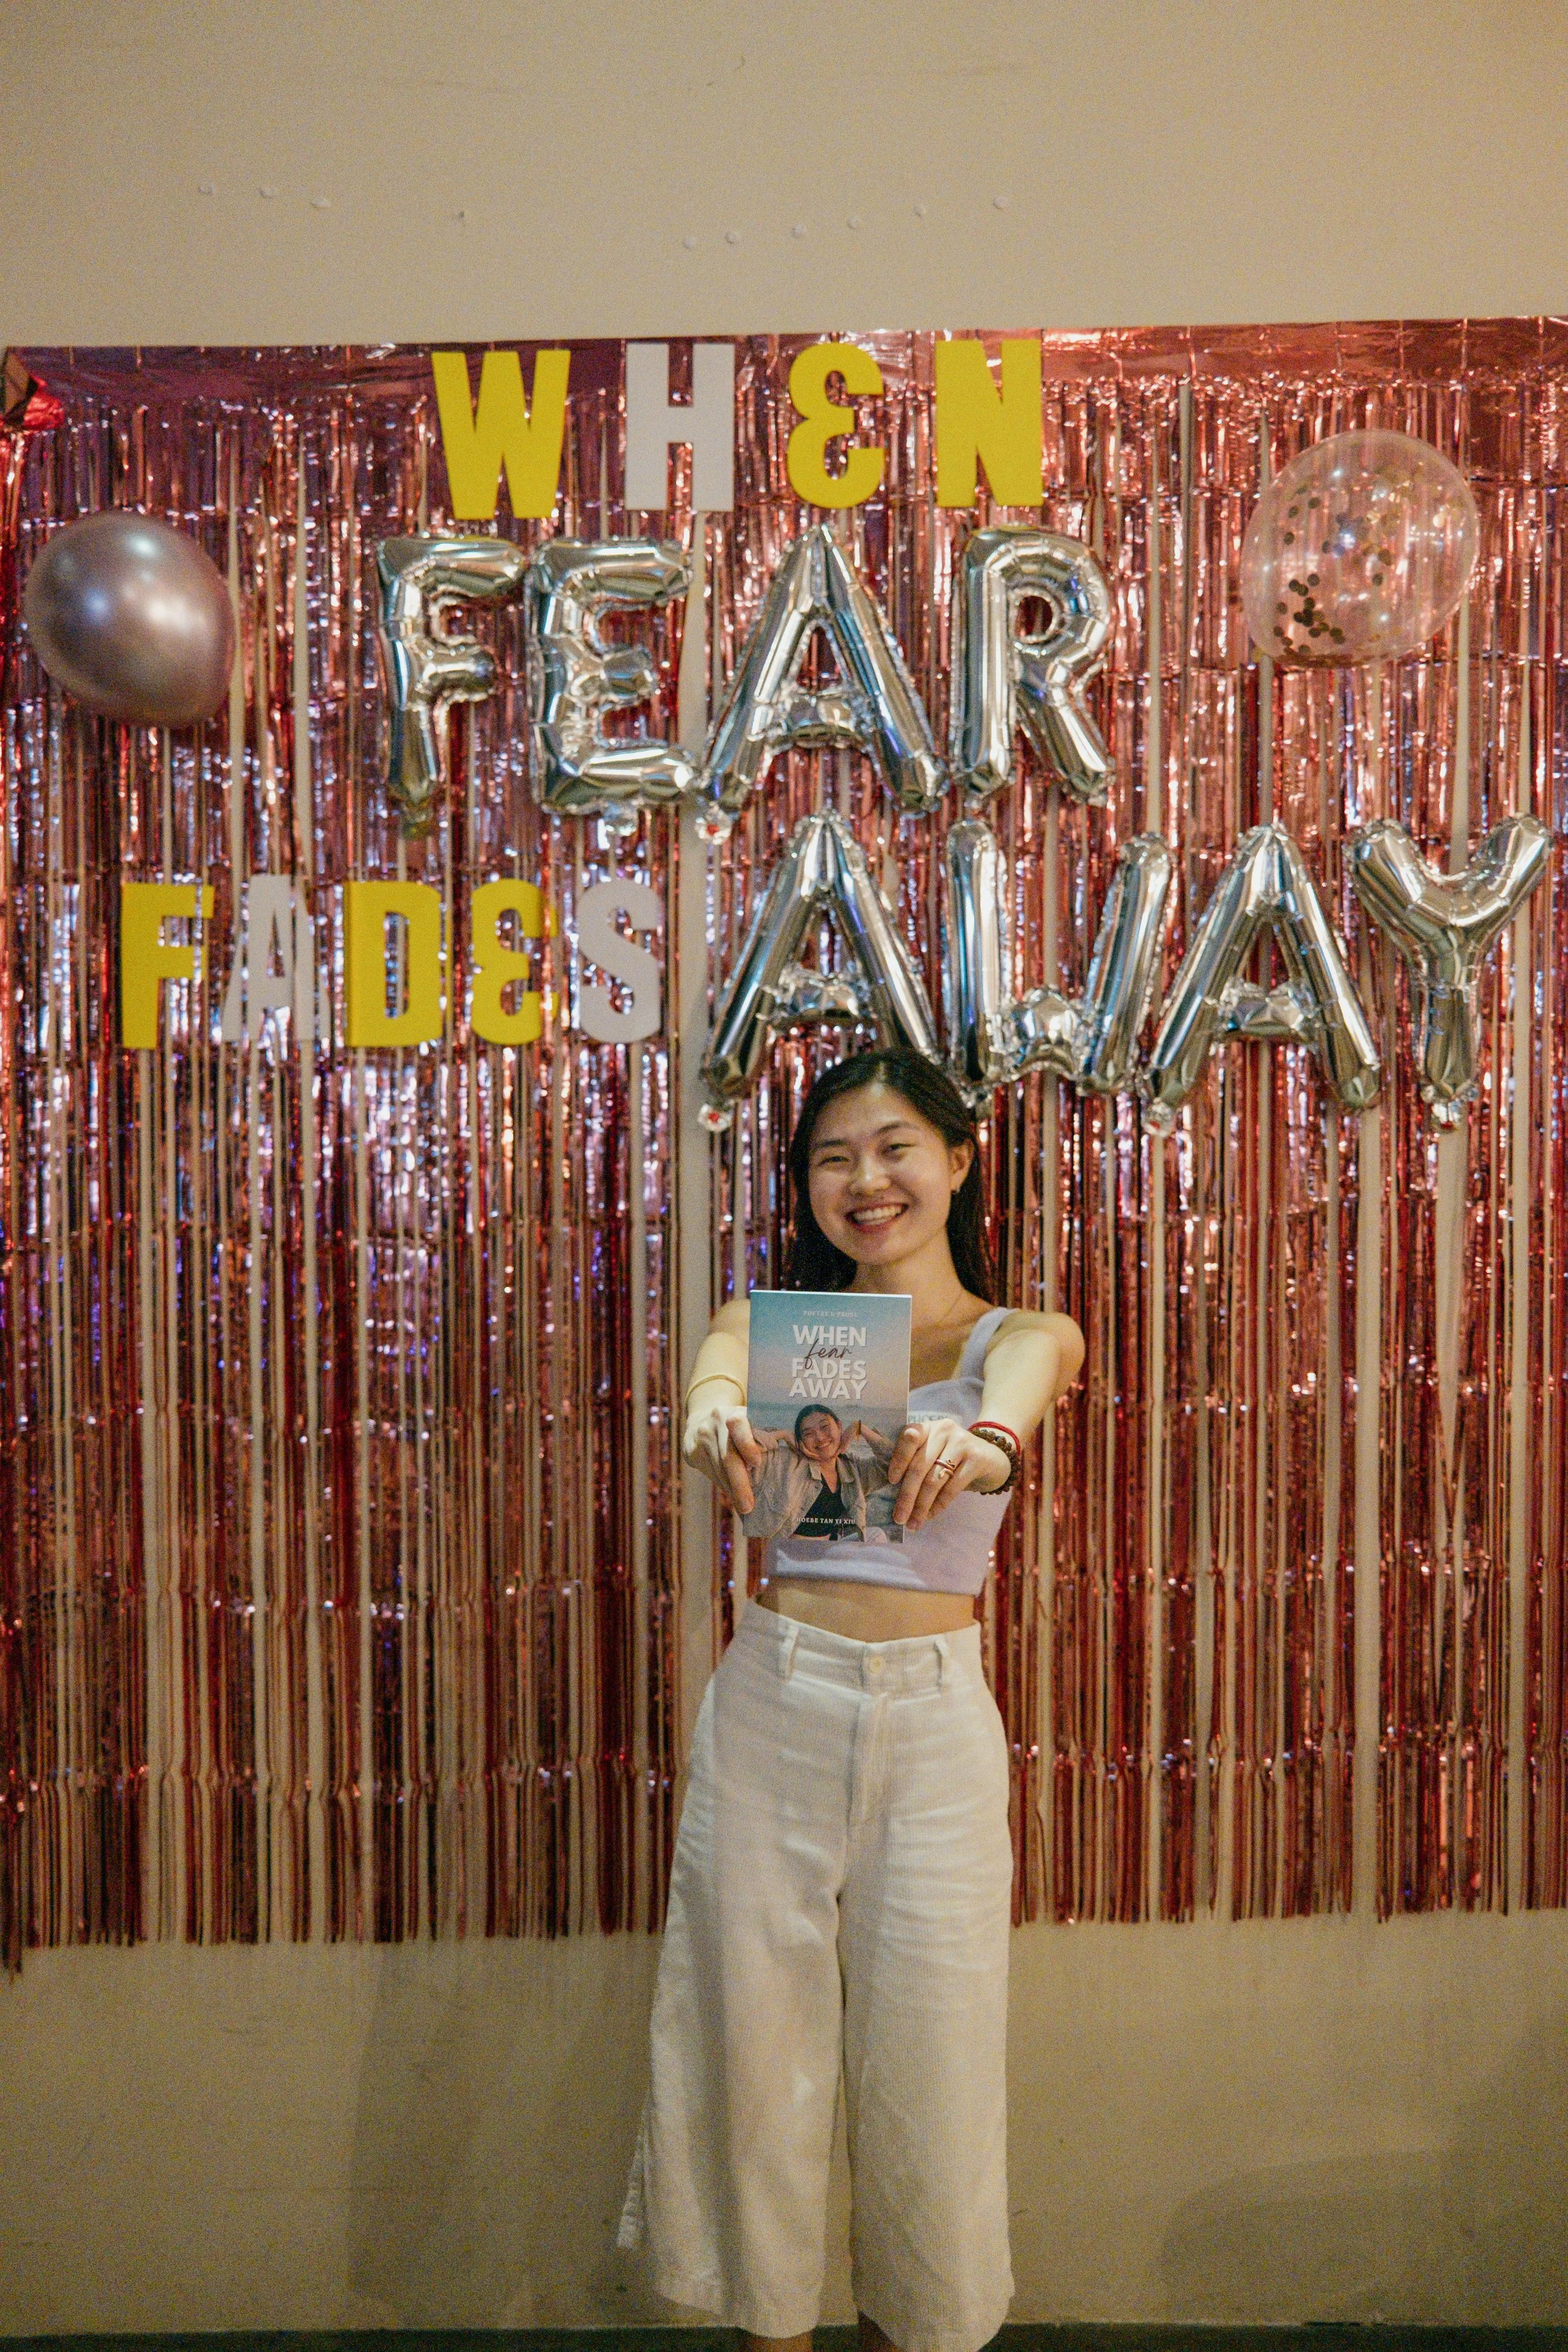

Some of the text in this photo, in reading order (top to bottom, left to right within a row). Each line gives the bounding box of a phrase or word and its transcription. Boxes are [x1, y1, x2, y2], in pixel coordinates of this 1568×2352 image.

[432, 339, 1044, 520] WHEN
[378, 523, 1115, 817] FEAR
[121, 810, 1552, 1112] FADES AWAY
[792, 1323, 867, 1347] WHEN
[792, 1358, 868, 1380] FADES
[804, 1337, 852, 1370] fear
[788, 1378, 868, 1400] AWAY
